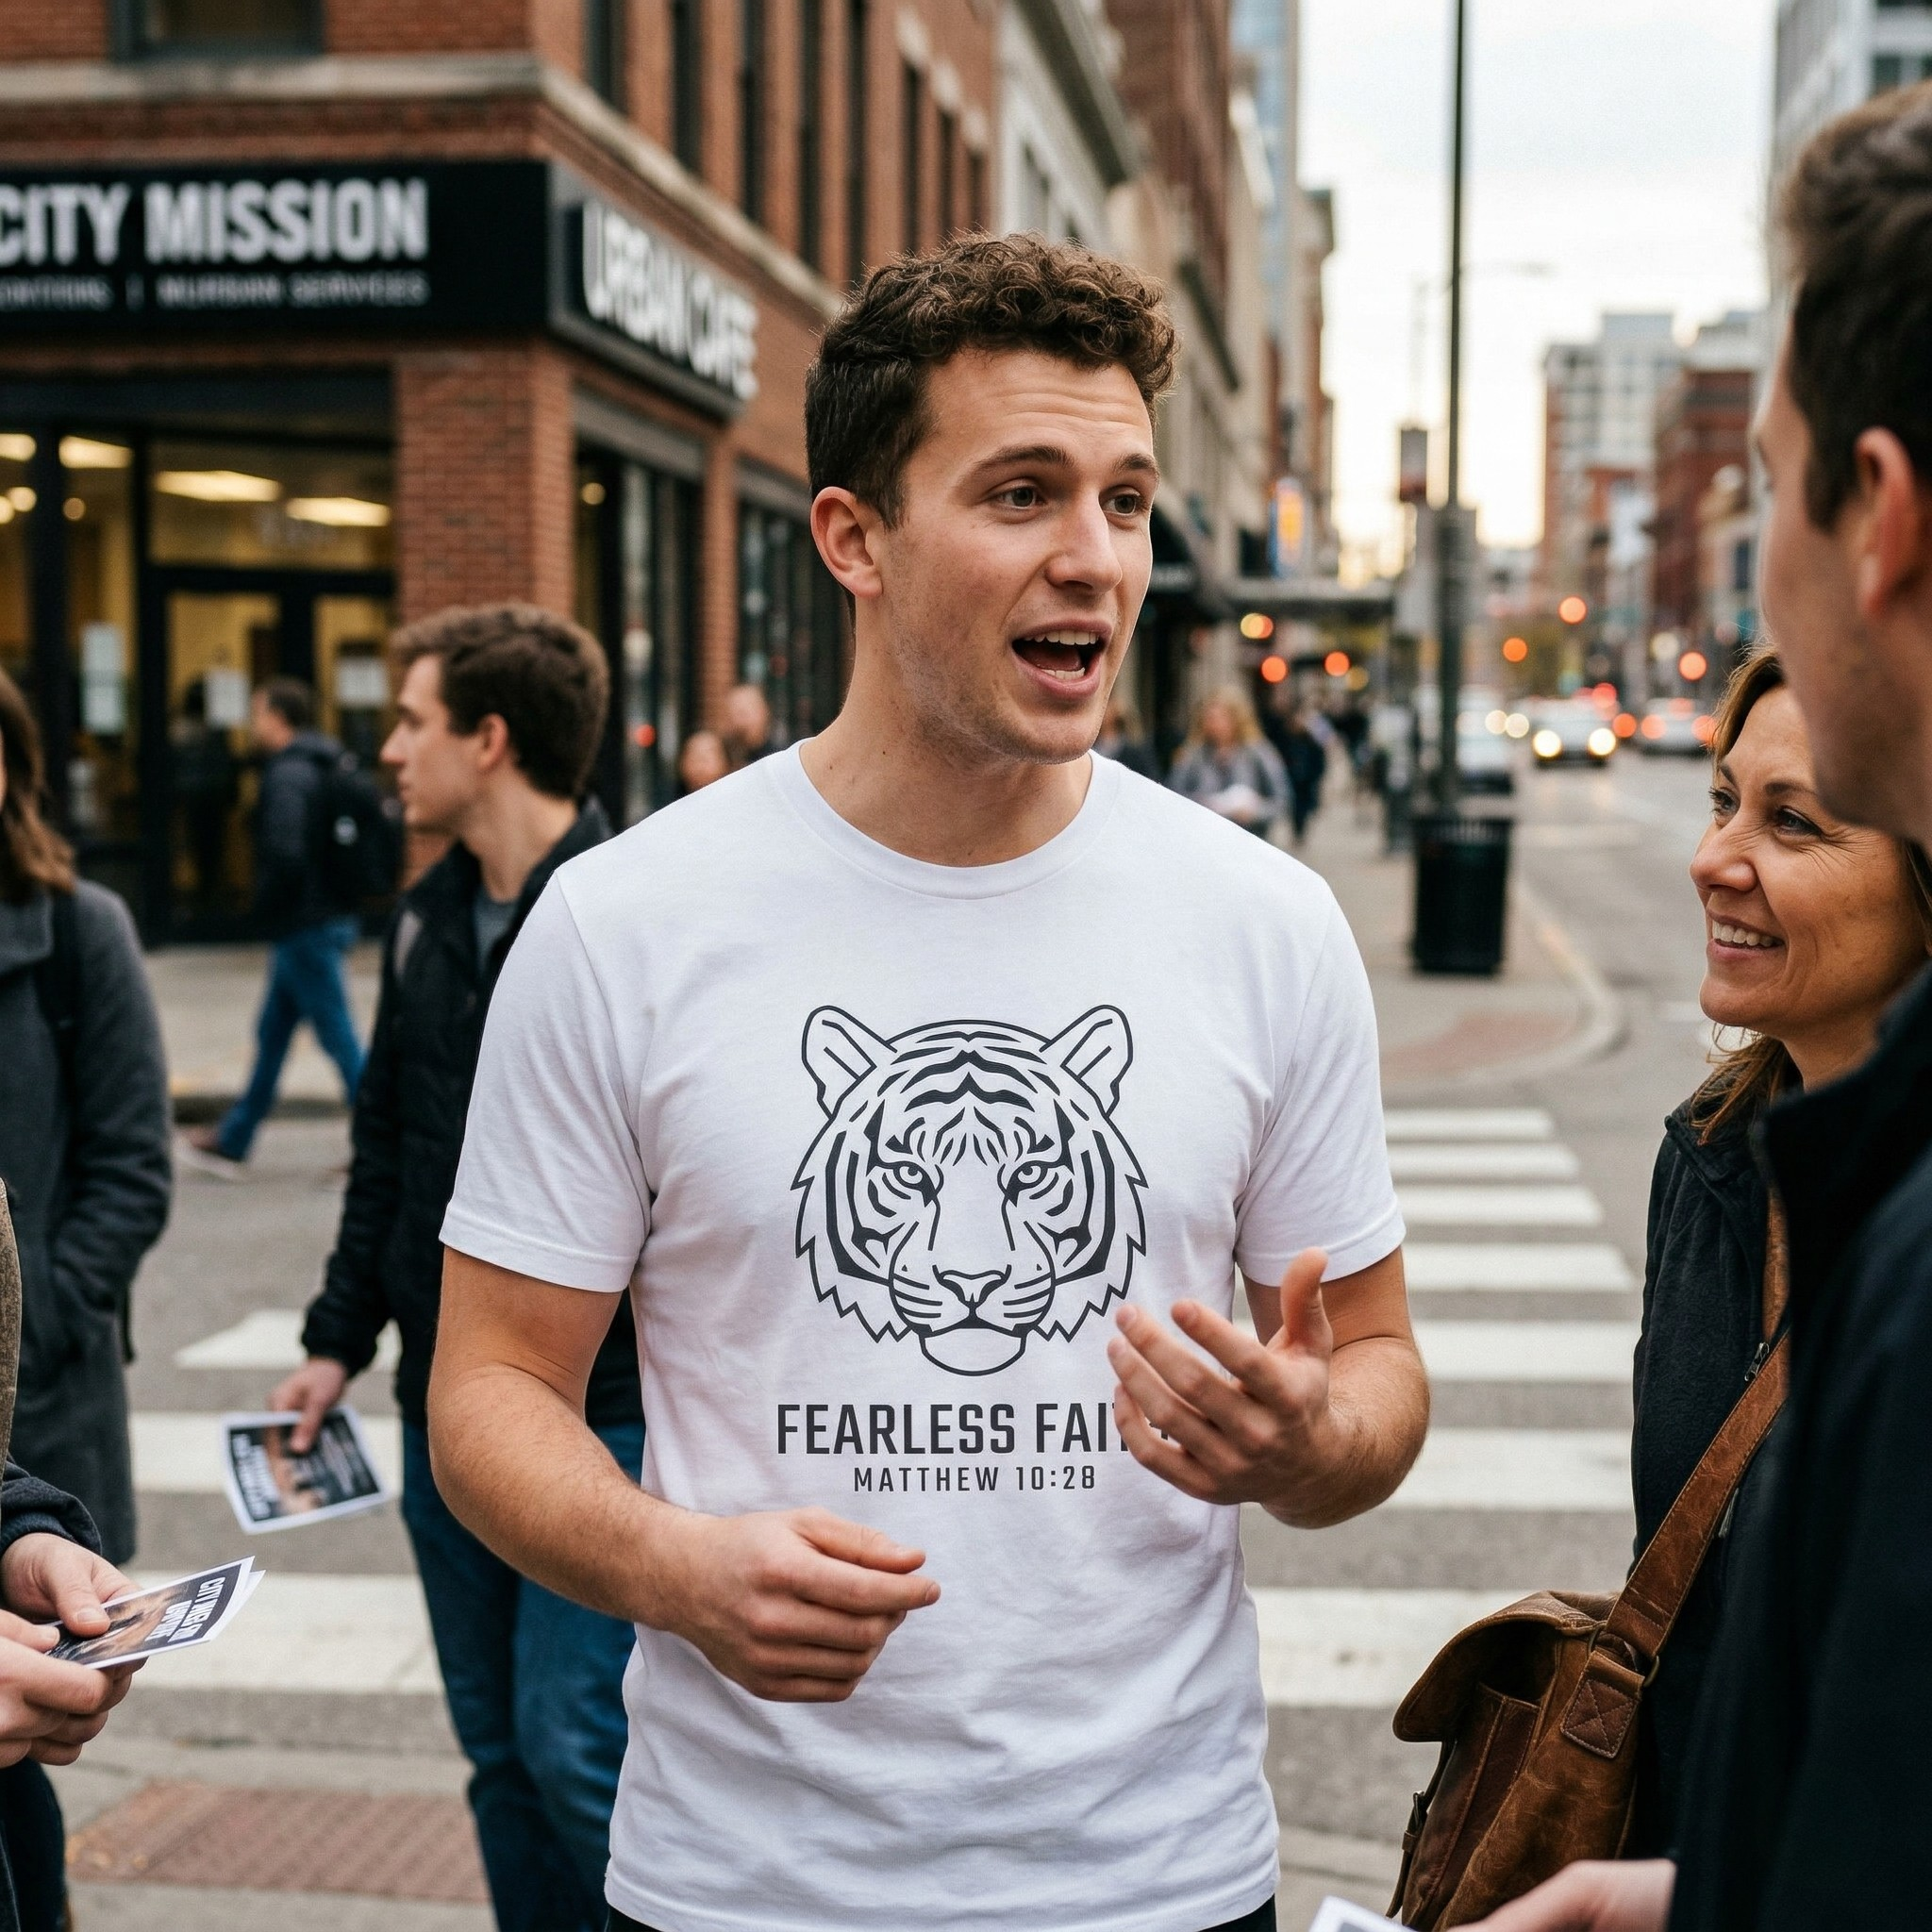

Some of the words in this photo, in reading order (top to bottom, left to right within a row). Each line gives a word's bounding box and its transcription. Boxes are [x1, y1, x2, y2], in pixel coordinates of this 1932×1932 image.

[0, 183, 129, 266] CITY
[143, 179, 428, 263] MISSION
[777, 1404, 1016, 1455] FEARLESS
[1036, 1403, 1171, 1454] FAI
[854, 1466, 999, 1492] MATTHEW
[1016, 1465, 1095, 1491] 10:28
